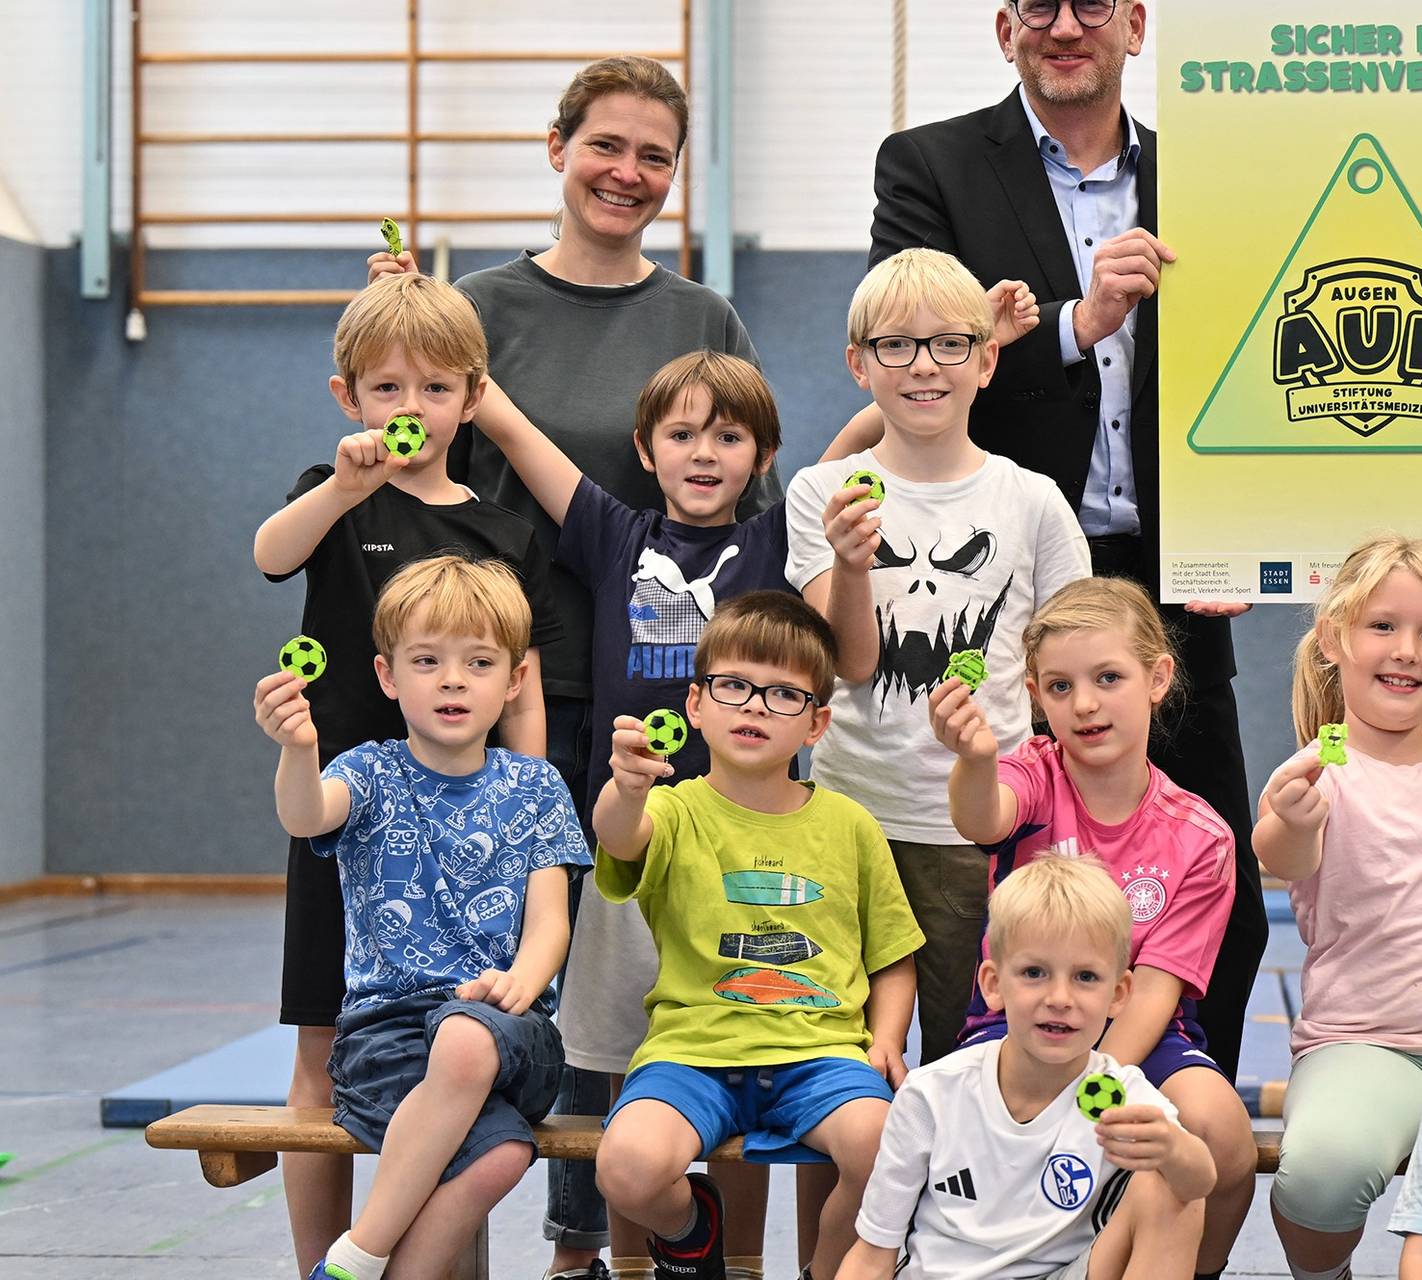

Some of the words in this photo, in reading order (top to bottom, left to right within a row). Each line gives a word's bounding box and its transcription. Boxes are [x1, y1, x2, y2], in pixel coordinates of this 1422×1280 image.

[1270, 24, 1402, 56] SICHER
[1331, 286, 1397, 301] AUGEN
[1333, 387, 1393, 398] STIFTUNG
[362, 543, 395, 552] KIPSTA
[1179, 561, 1229, 569] Zusammenarbeit
[1212, 570, 1231, 578] Essen,
[1235, 587, 1252, 595] Sport
